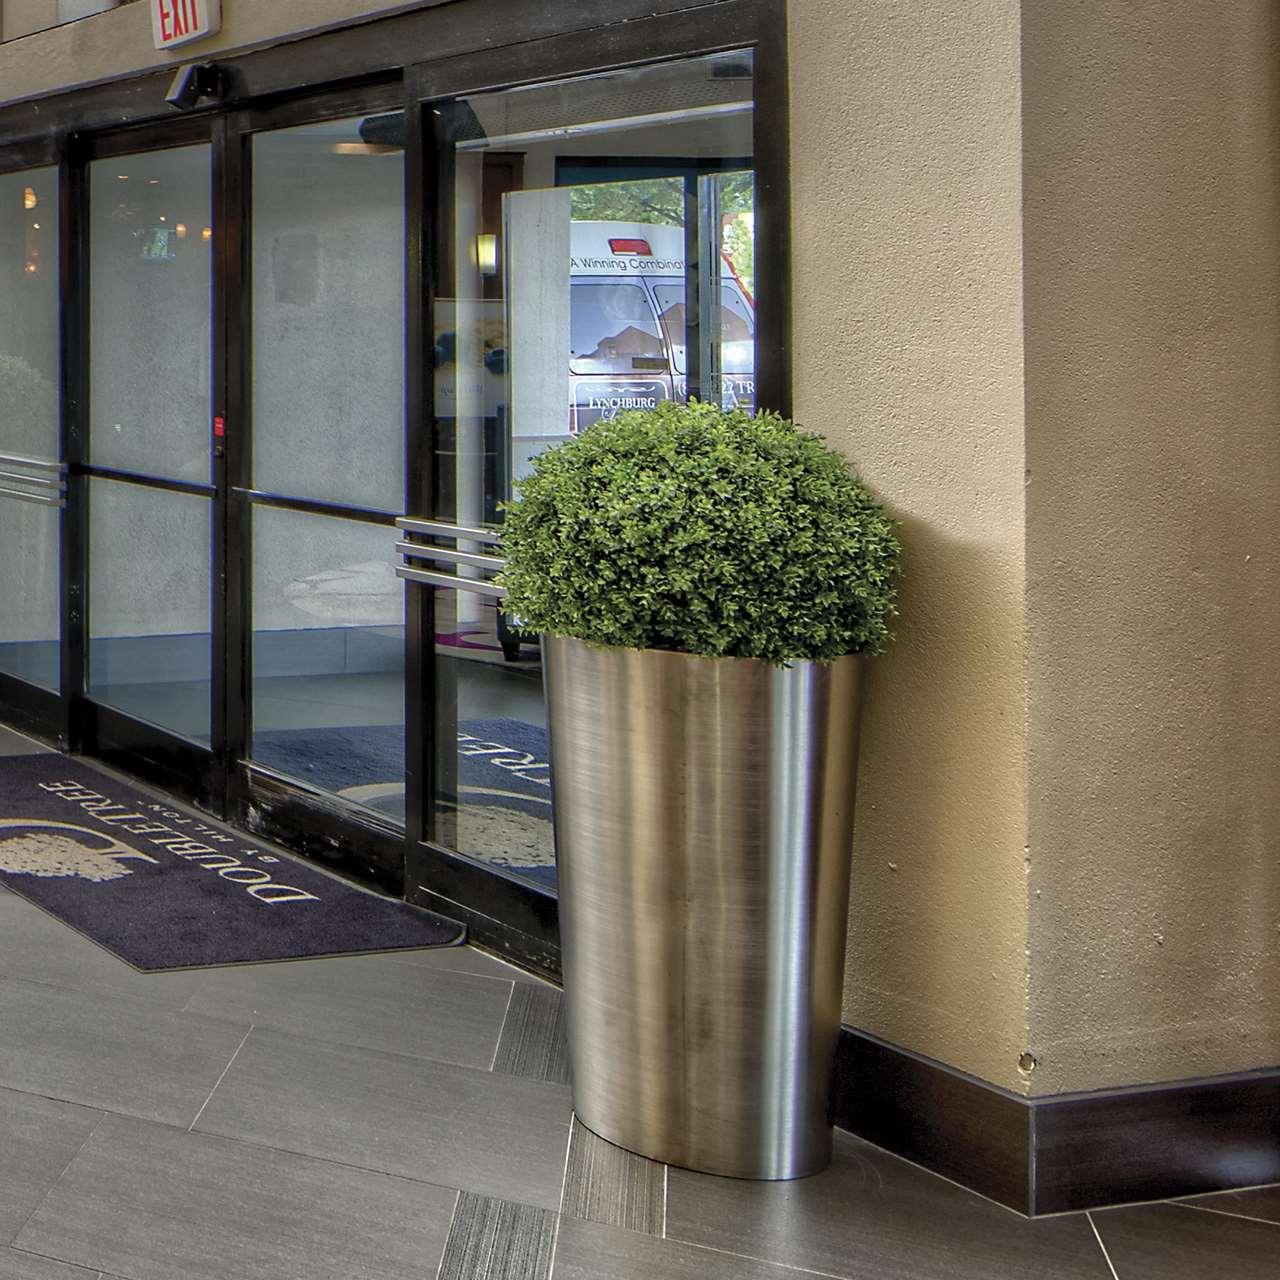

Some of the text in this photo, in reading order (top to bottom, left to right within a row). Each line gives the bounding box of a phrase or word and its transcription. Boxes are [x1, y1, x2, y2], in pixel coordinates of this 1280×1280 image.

[581, 258, 628, 271] Winning
[589, 397, 656, 409] LYNCHBURG
[39, 780, 321, 905] DOUBLETREE
[240, 848, 280, 864] BY
